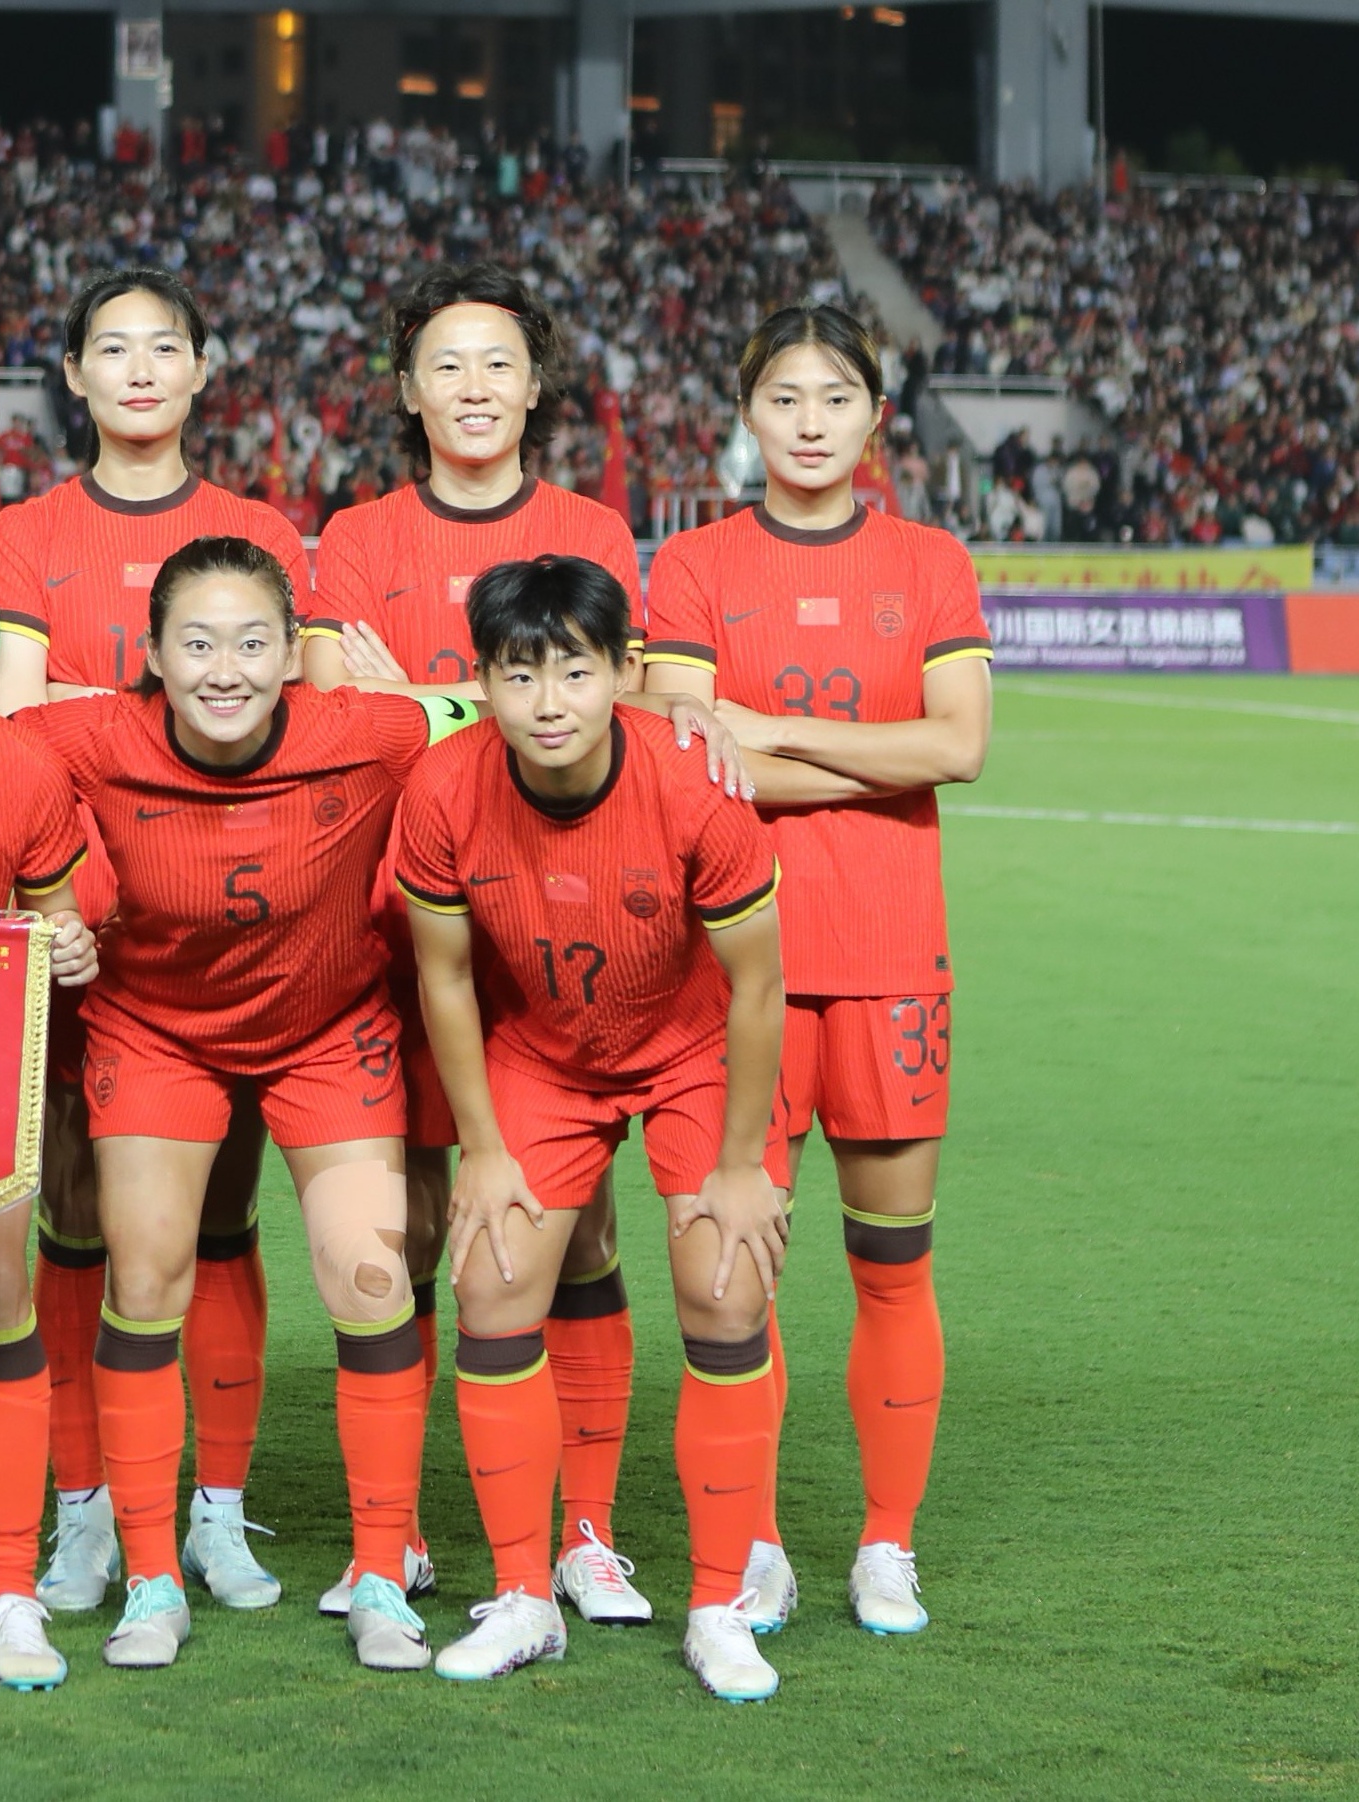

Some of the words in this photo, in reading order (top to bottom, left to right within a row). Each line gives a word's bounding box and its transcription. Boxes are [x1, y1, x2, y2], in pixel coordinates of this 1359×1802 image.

[109, 625, 147, 682] 1
[987, 607, 1245, 648] 川国际女足锦标赛
[774, 665, 862, 722] 33
[225, 864, 270, 927] 5
[534, 938, 607, 1005] 17
[352, 1018, 392, 1077] 5
[891, 995, 949, 1076] 33
